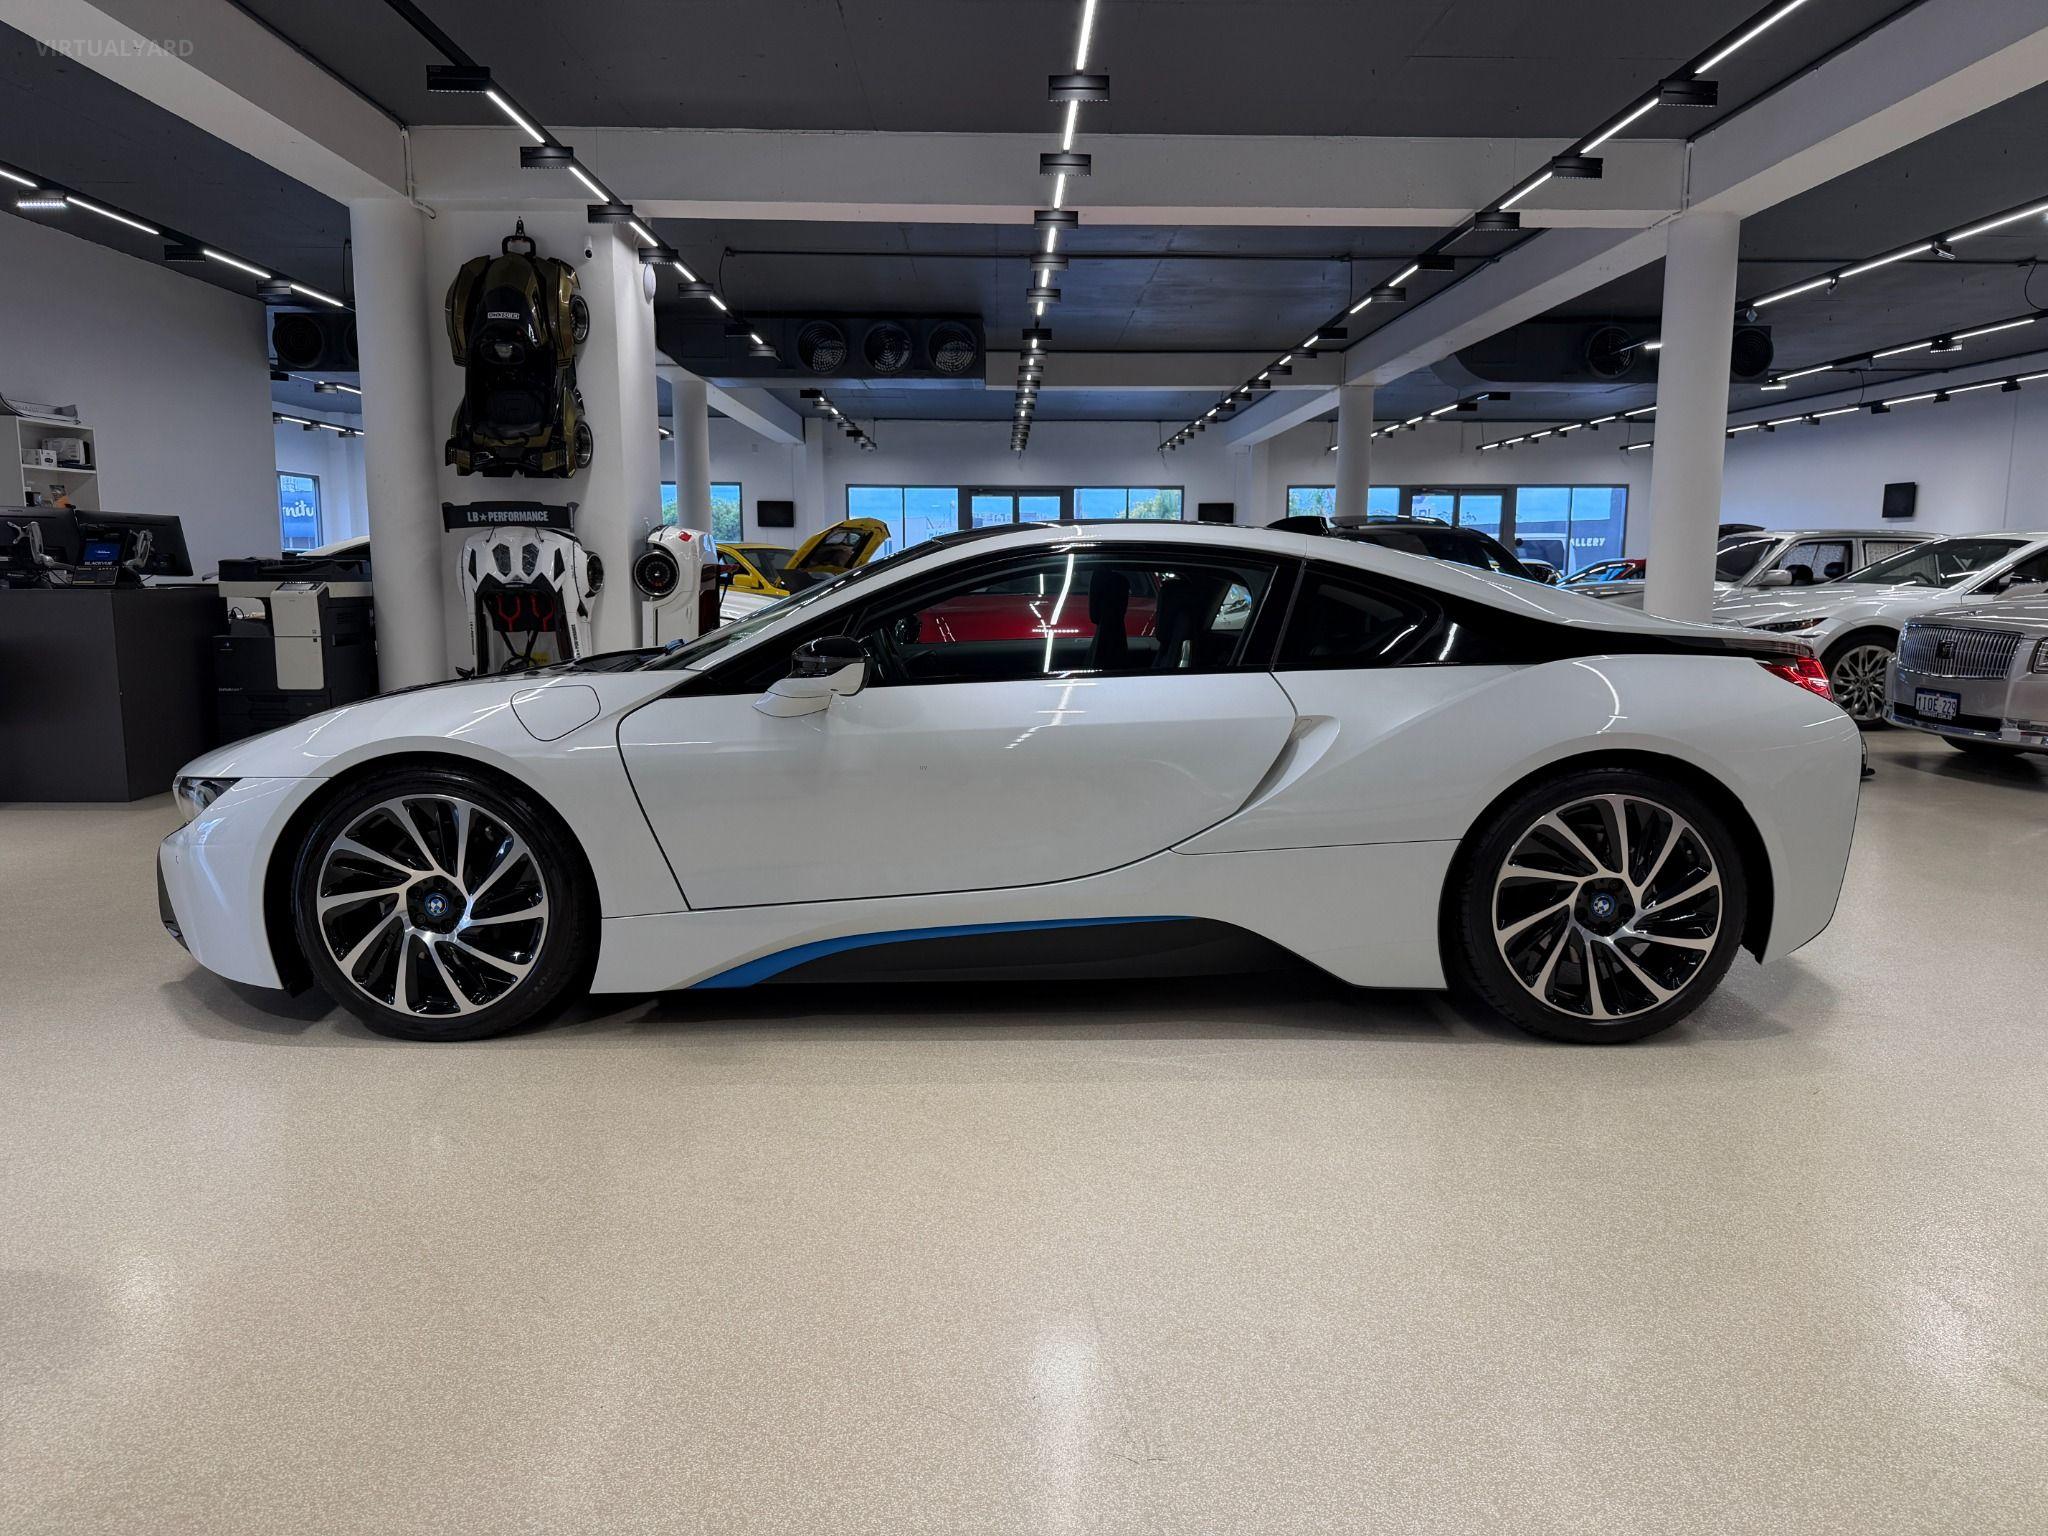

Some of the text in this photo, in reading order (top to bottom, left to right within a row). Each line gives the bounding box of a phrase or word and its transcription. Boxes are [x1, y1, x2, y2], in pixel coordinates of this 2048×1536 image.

[282, 500, 314, 517] nitu
[467, 511, 549, 522] LB PERFORMANCE
